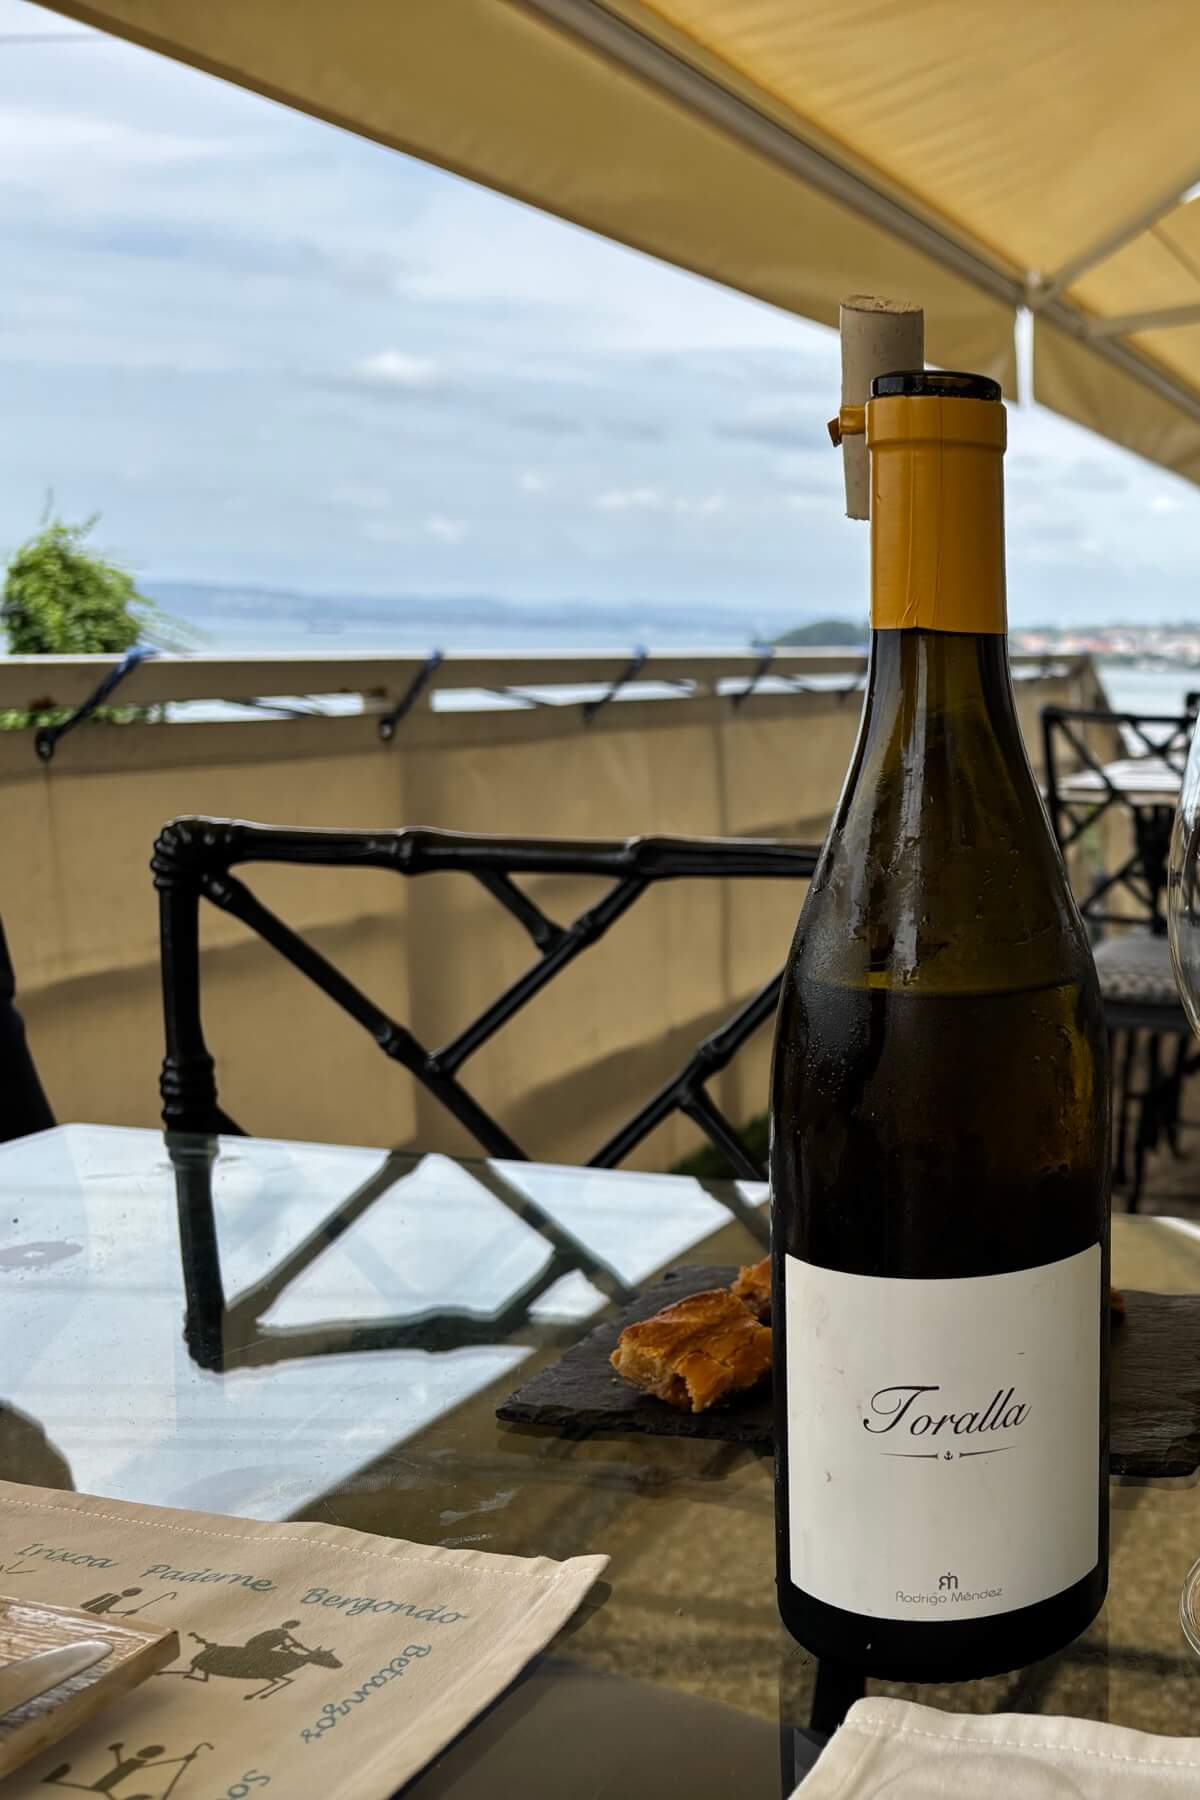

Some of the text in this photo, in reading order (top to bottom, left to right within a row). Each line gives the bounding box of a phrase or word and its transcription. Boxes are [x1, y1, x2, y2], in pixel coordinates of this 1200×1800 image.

[863, 1386, 1032, 1436] Toralla
[15, 1543, 469, 1625] Irixoa Paderne Bergondo
[895, 1590, 947, 1606] Rodrigo
[300, 1644, 432, 1743] Betanzos
